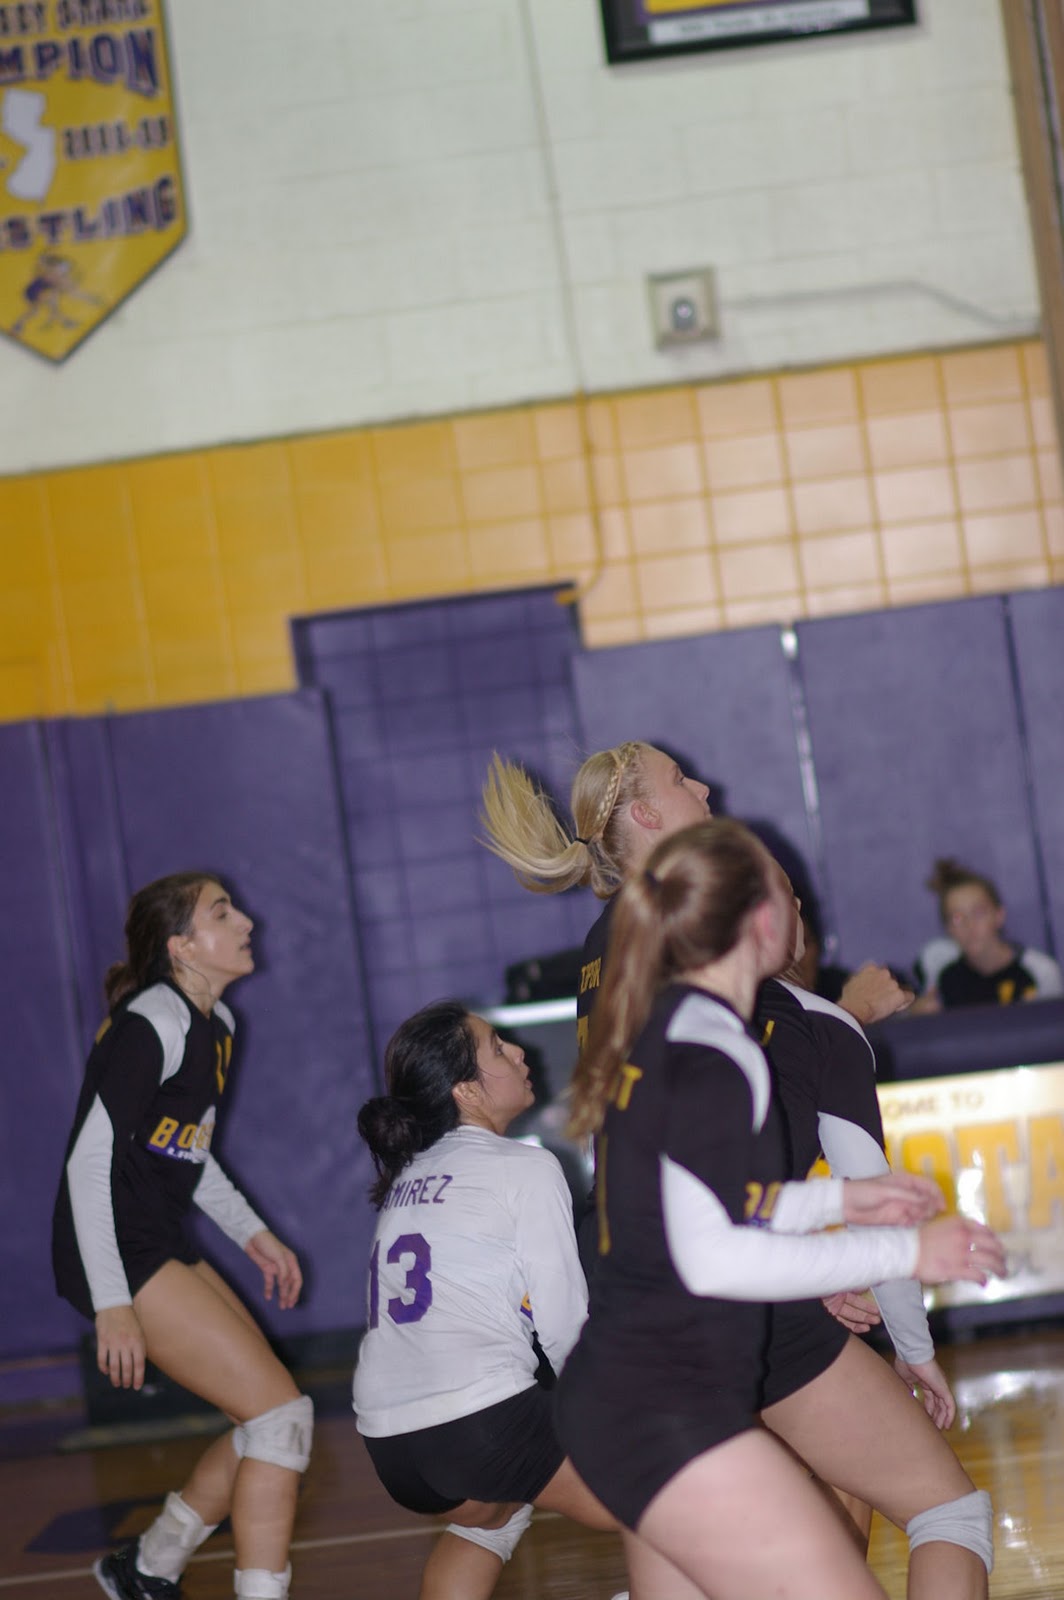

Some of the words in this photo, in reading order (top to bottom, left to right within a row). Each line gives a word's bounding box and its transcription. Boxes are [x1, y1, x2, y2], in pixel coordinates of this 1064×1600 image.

[0, 28, 160, 98] MPION
[0, 175, 176, 248] STLING
[883, 1094, 937, 1119] OME
[951, 1090, 984, 1110] TO
[384, 1174, 453, 1211] MIREZ
[882, 1113, 1064, 1235] OTA
[369, 1232, 433, 1330] 13
